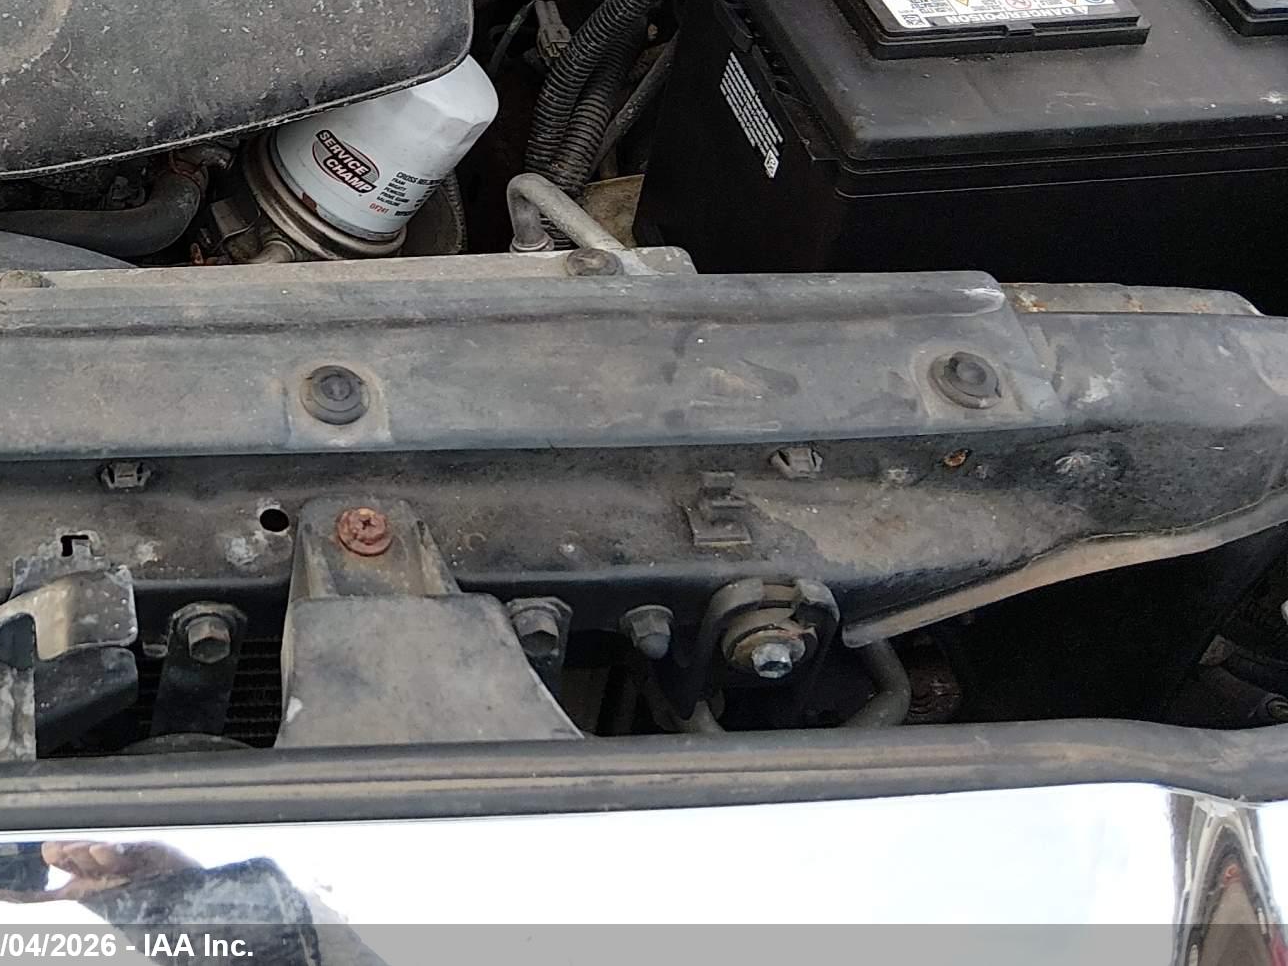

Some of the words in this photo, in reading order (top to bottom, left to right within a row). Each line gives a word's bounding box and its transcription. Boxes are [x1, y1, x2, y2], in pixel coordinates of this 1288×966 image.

[945, 7, 1075, 24] DANGER/POISON
[319, 131, 369, 176] SERVICE
[326, 158, 373, 191] CHAMP
